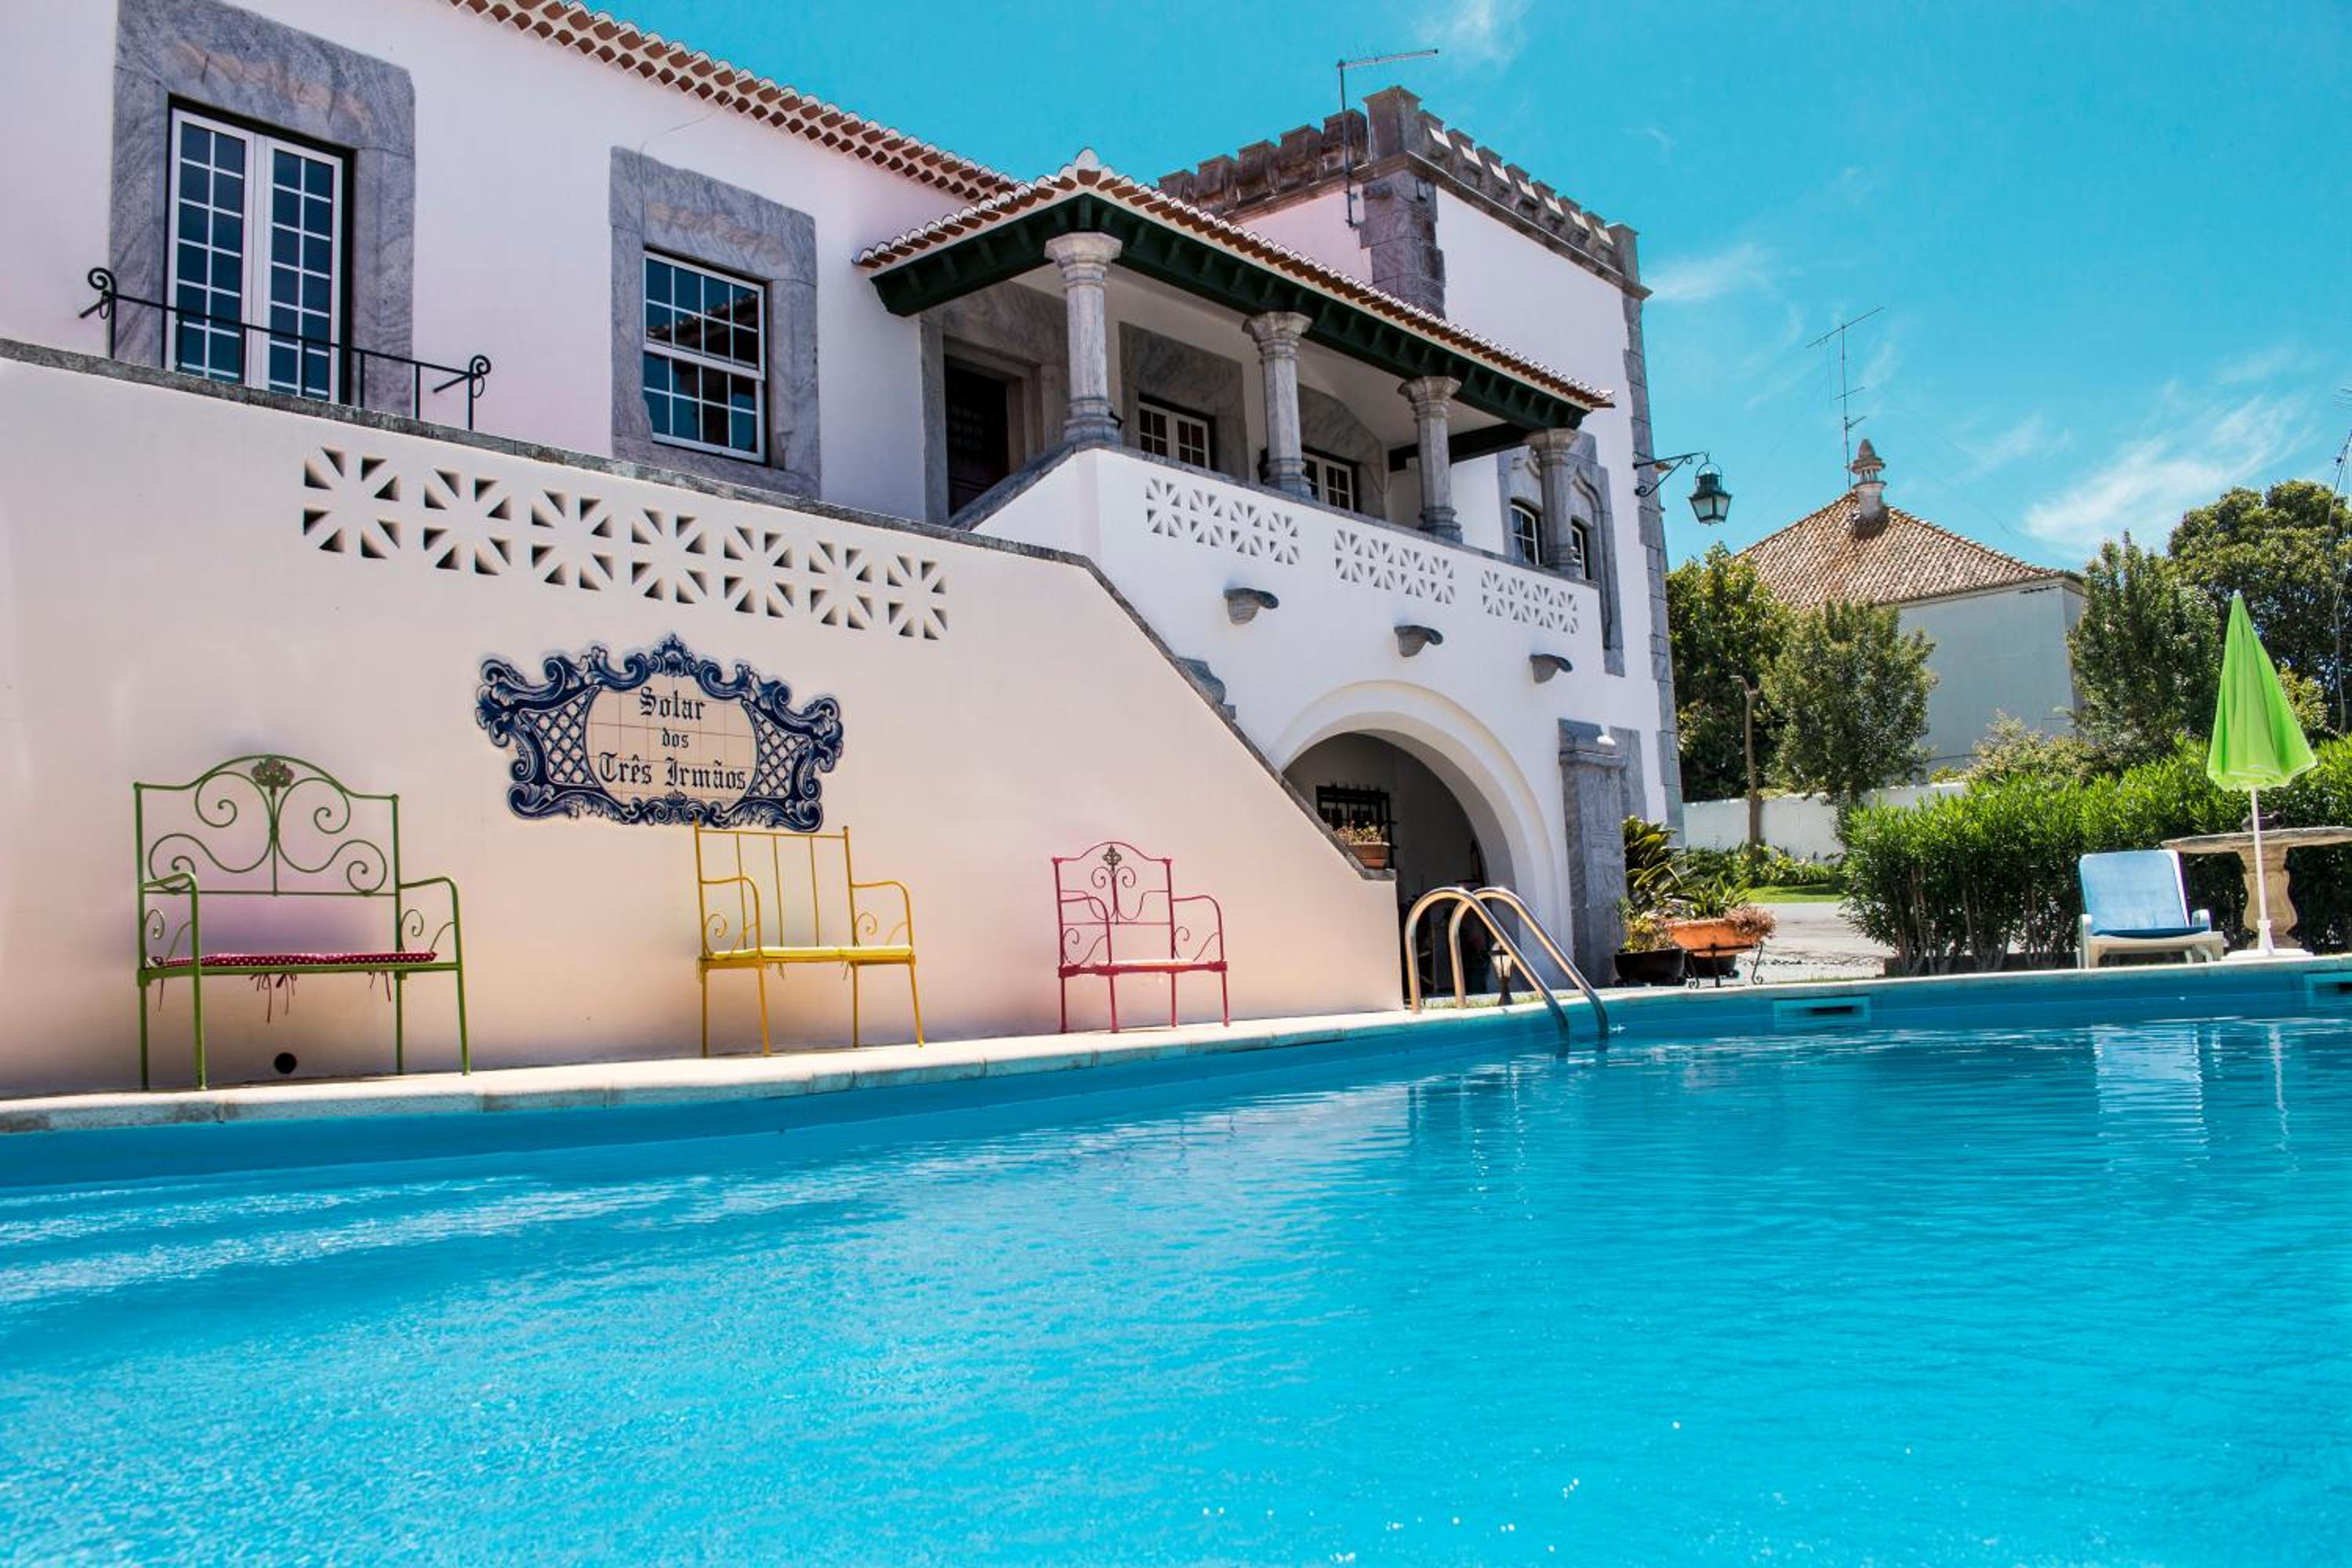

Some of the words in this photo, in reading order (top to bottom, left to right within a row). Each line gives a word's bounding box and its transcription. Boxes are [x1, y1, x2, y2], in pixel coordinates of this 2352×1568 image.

[640, 686, 706, 720] Solar
[662, 728, 689, 748] dos
[600, 752, 652, 785] Três
[665, 757, 746, 790] Irmãos
